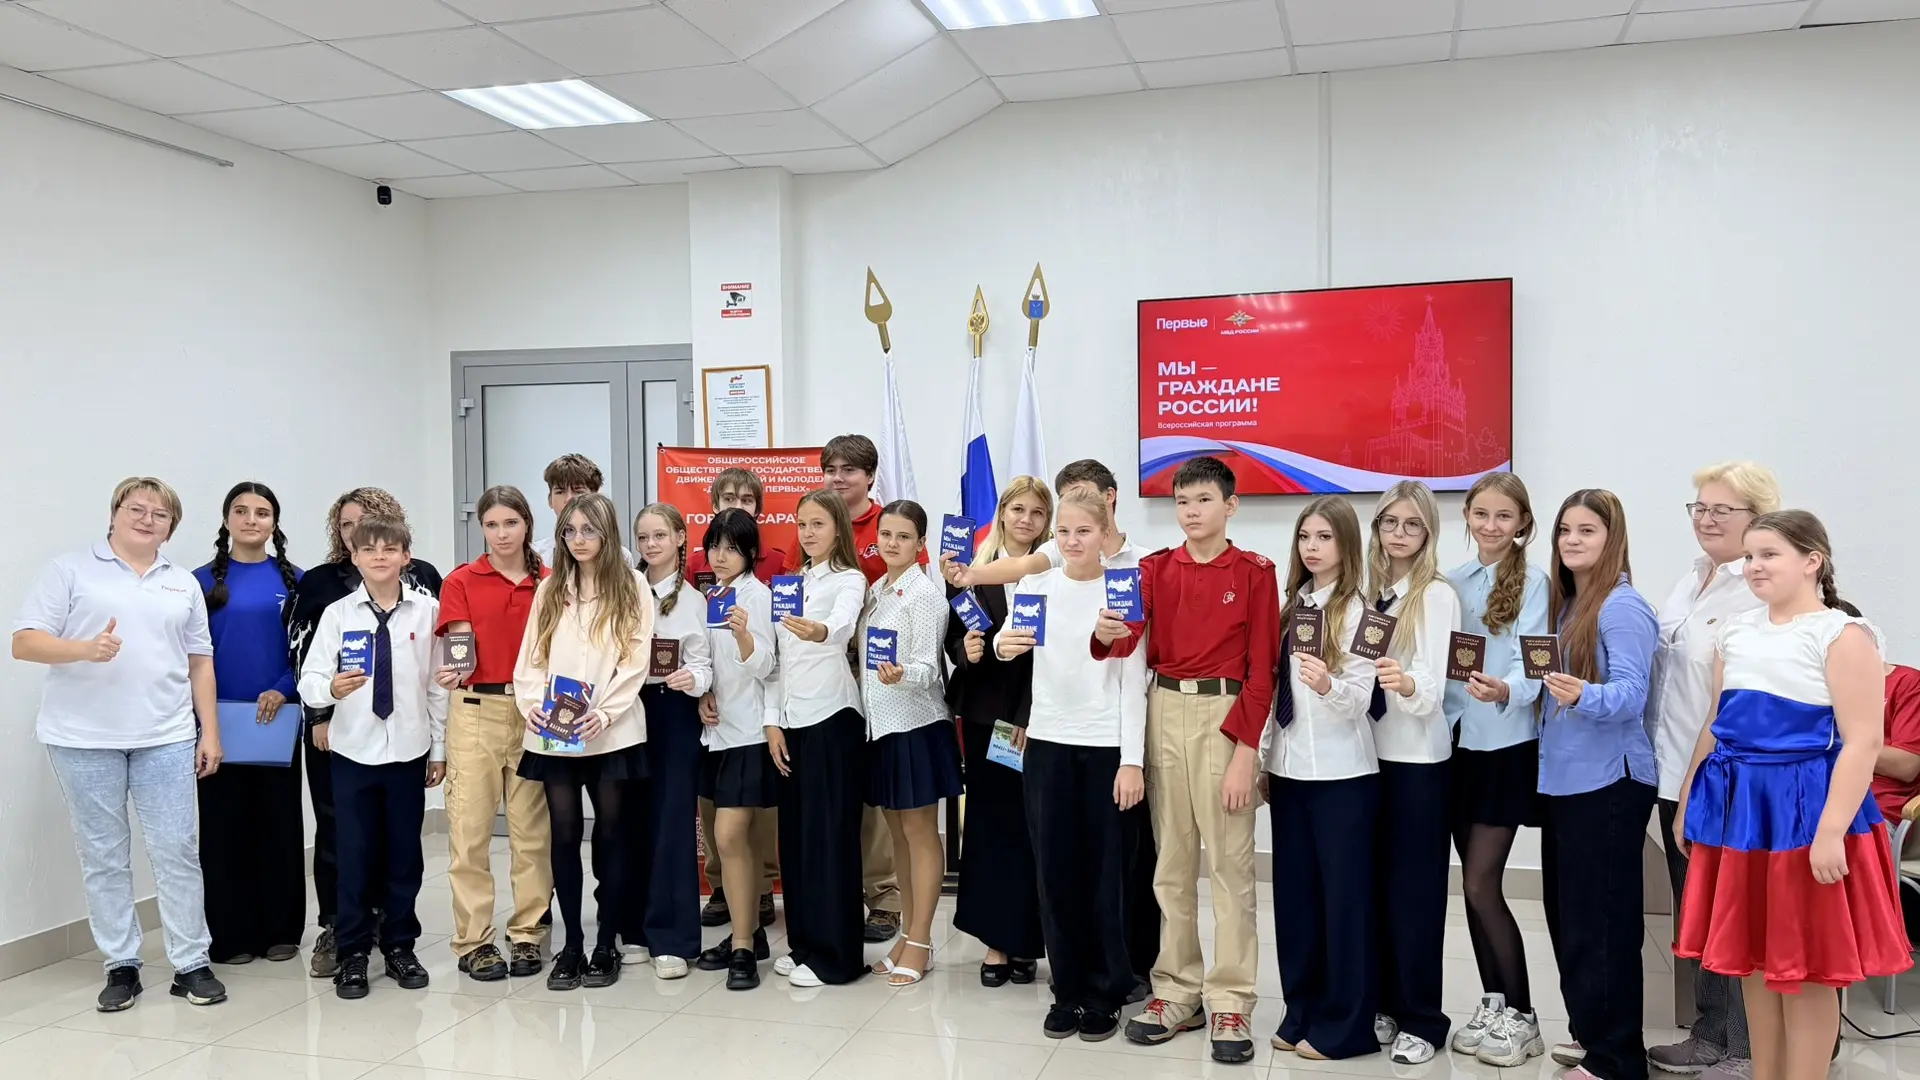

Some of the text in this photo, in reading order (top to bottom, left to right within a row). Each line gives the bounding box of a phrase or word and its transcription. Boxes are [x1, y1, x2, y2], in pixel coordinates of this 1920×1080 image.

[1156, 318, 1208, 332] Первые
[1158, 361, 1196, 376] МЫ
[1158, 377, 1280, 396] ГРАЖДАНЕ
[1158, 398, 1258, 415] РОССИИ!
[1157, 420, 1258, 430] Всероссийская программа
[707, 456, 806, 465] ОБЩЕРОССИЙСКОЕ
[751, 466, 823, 474] ГОСУДАРСТВЕ
[686, 513, 798, 524] ГОР САРА
[1451, 669, 1470, 677] ПАСПО
